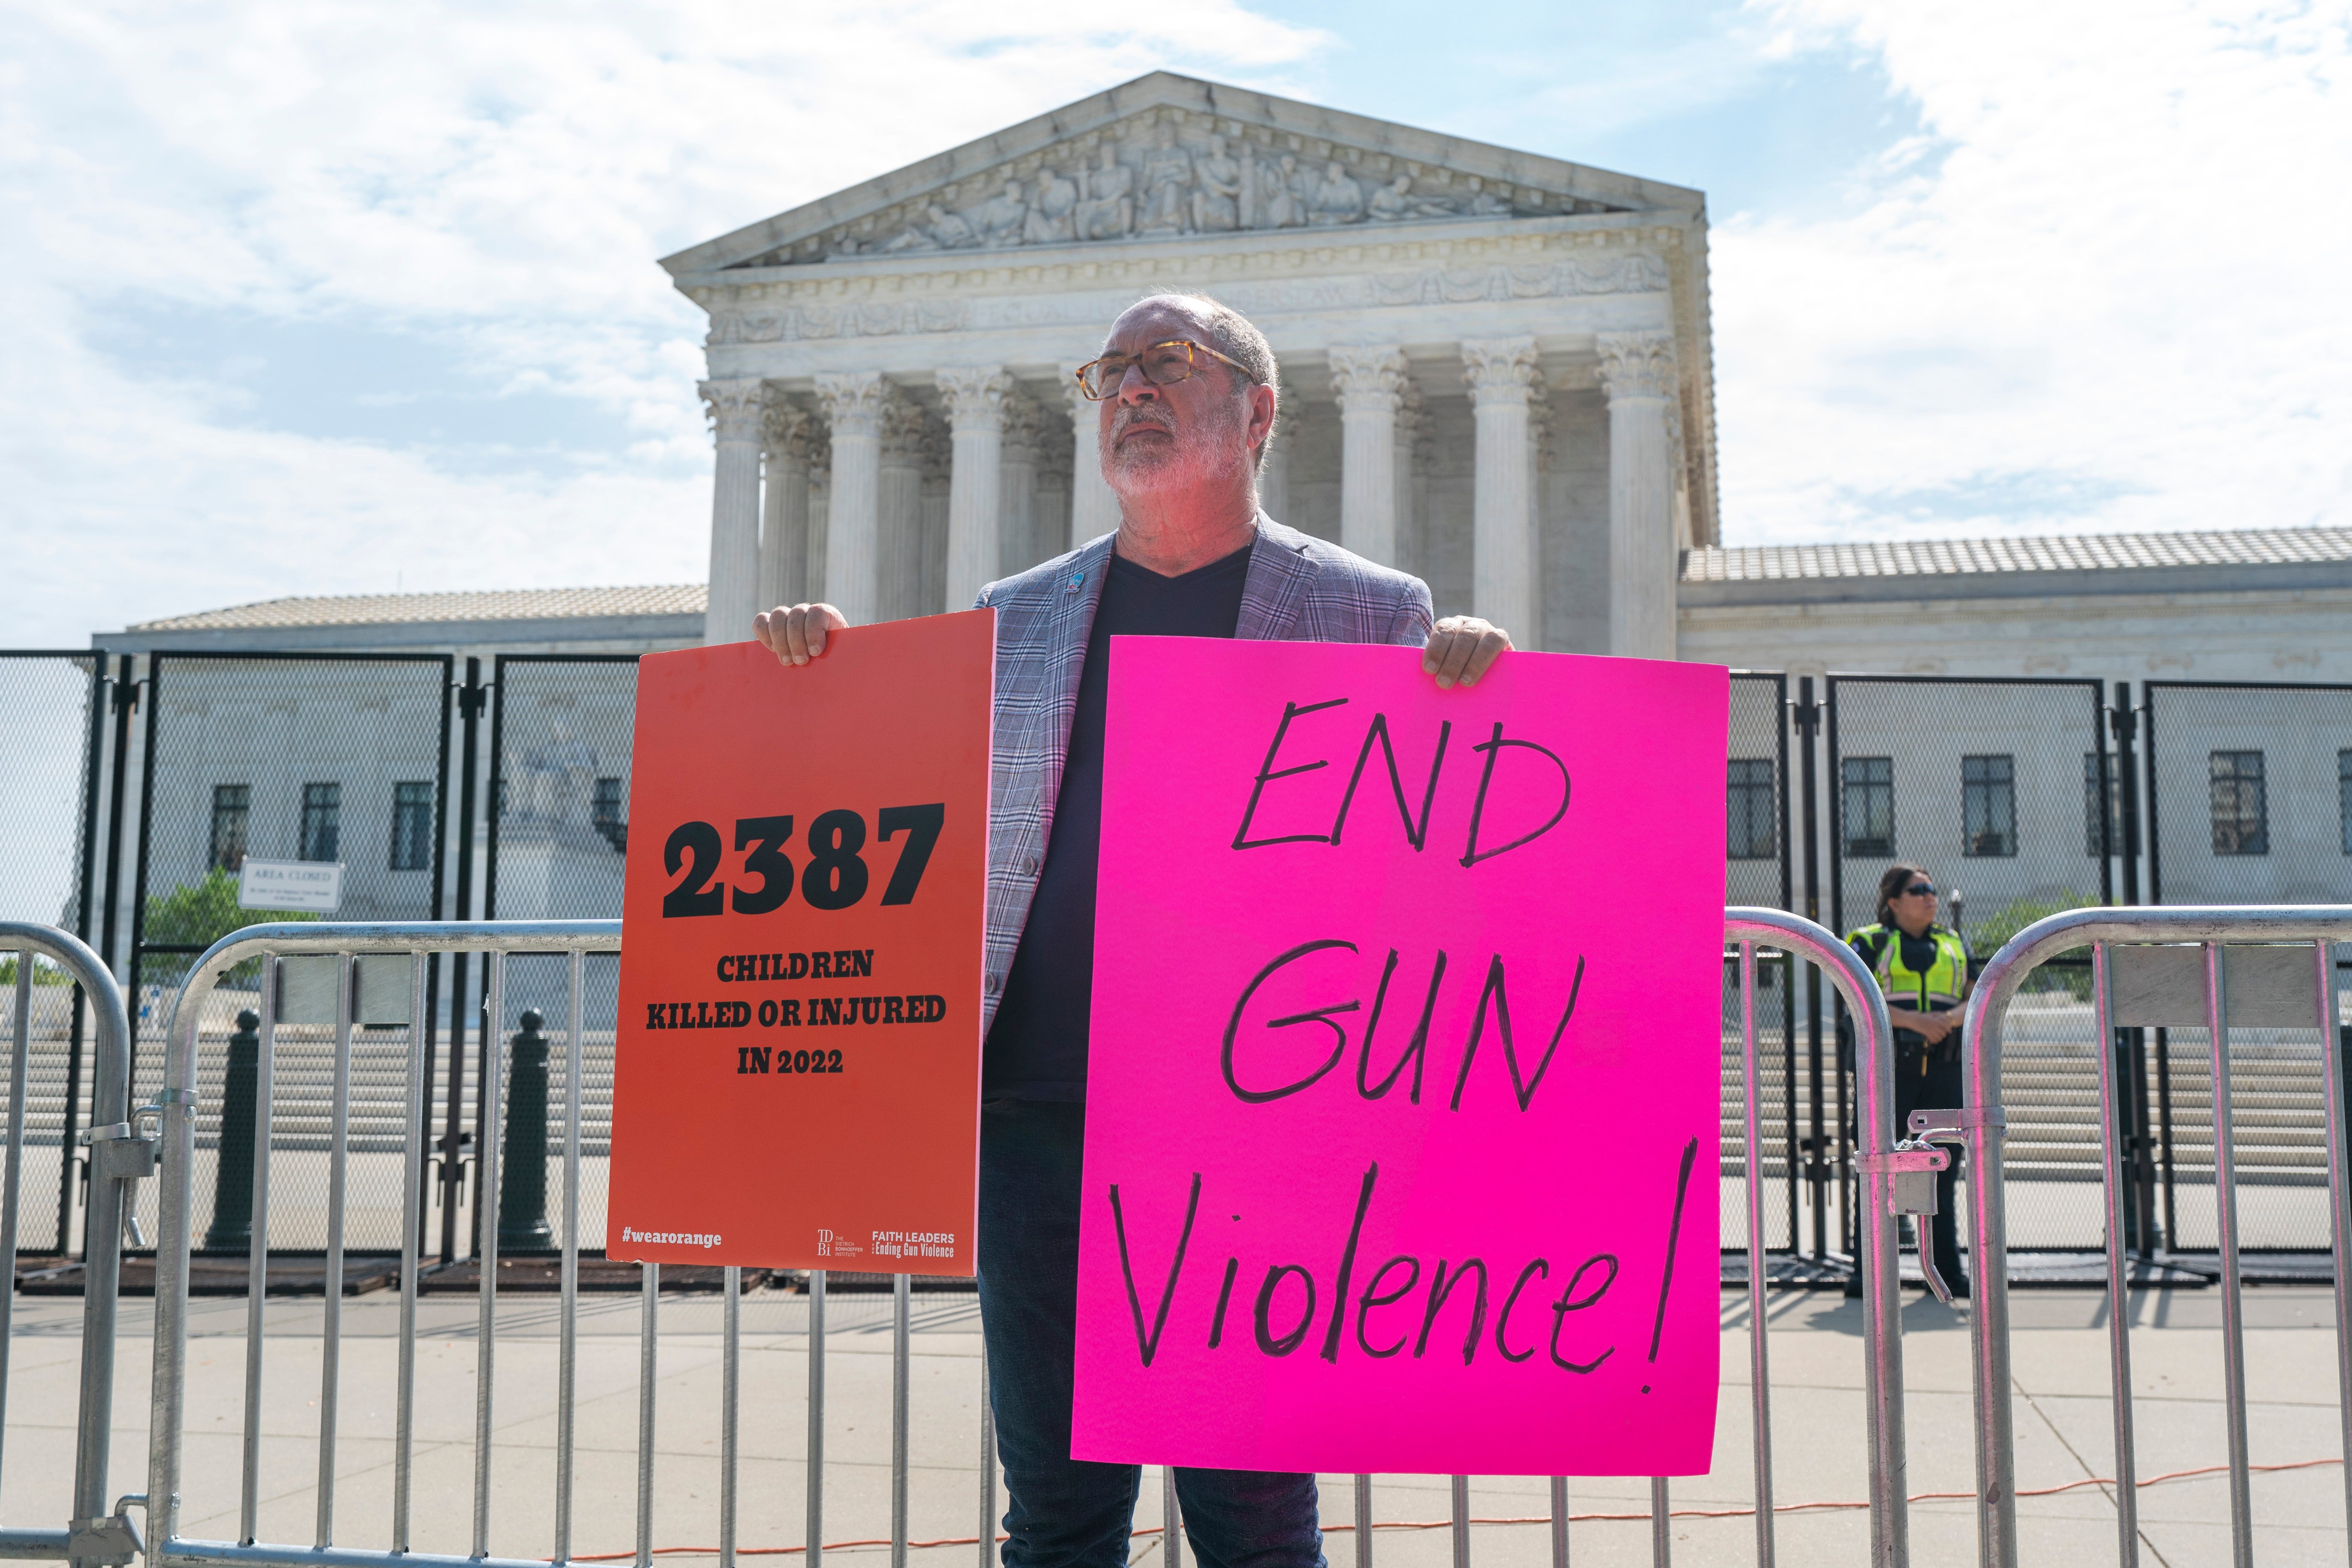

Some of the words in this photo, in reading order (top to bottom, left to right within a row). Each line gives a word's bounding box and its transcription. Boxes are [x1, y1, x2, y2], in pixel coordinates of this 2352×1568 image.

[1231, 698, 1571, 869] END
[662, 802, 945, 919] 2387
[717, 949, 874, 982] CHILDREN
[646, 1001, 752, 1030] KILLED
[758, 999, 801, 1027] OR
[807, 995, 946, 1026] INJURED
[1220, 939, 1585, 1112] GUN
[737, 1047, 772, 1074] IN
[777, 1049, 843, 1074] 2022
[622, 1227, 722, 1248] #wearorange
[872, 1231, 903, 1242] FAITH
[905, 1232, 954, 1244] LEADERS
[875, 1242, 902, 1259] Ending
[904, 1242, 918, 1256] Gun
[920, 1243, 954, 1258] Violence
[1108, 1135, 1698, 1394] Violence!
